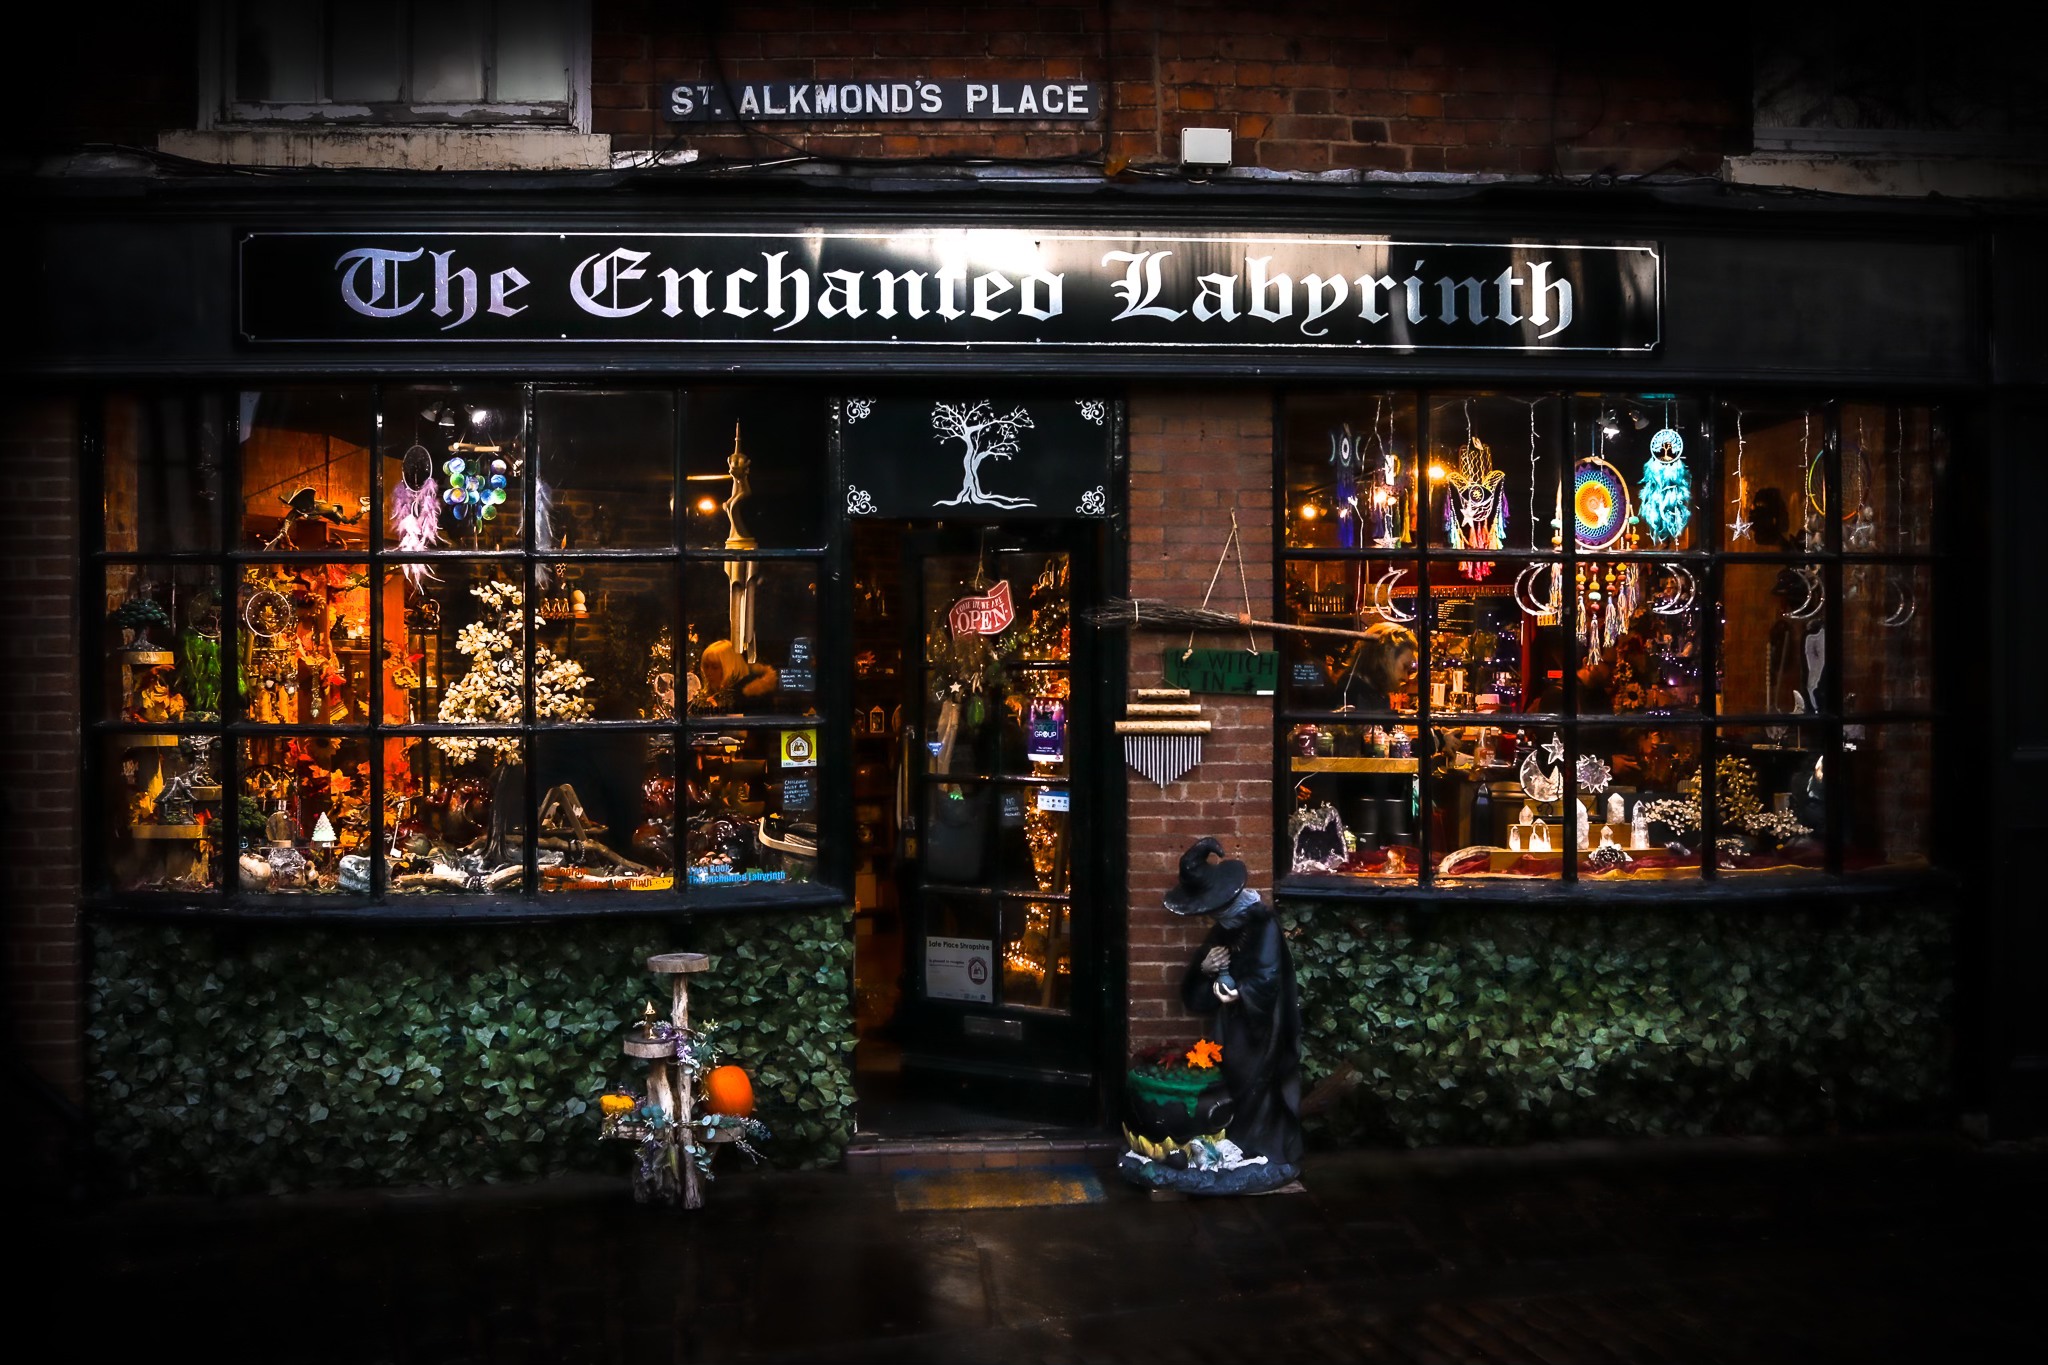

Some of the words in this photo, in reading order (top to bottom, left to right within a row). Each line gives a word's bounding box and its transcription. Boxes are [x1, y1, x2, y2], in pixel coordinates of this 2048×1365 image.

[671, 85, 723, 115] ST.
[739, 80, 943, 115] ALKMOND'S
[966, 84, 1090, 115] PLACE
[333, 246, 532, 331] The
[569, 246, 1066, 332] Enchanted
[1100, 249, 1576, 341] Labyrinth
[981, 601, 991, 610] WE
[991, 596, 1003, 608] ARE
[957, 603, 1007, 632] OPEN
[1207, 651, 1274, 674] WITCH
[1176, 670, 1191, 689] IS
[1201, 671, 1226, 692] IN
[1034, 730, 1057, 738] GROUP
[928, 940, 941, 948] Safe
[960, 942, 990, 951] Shropshire
